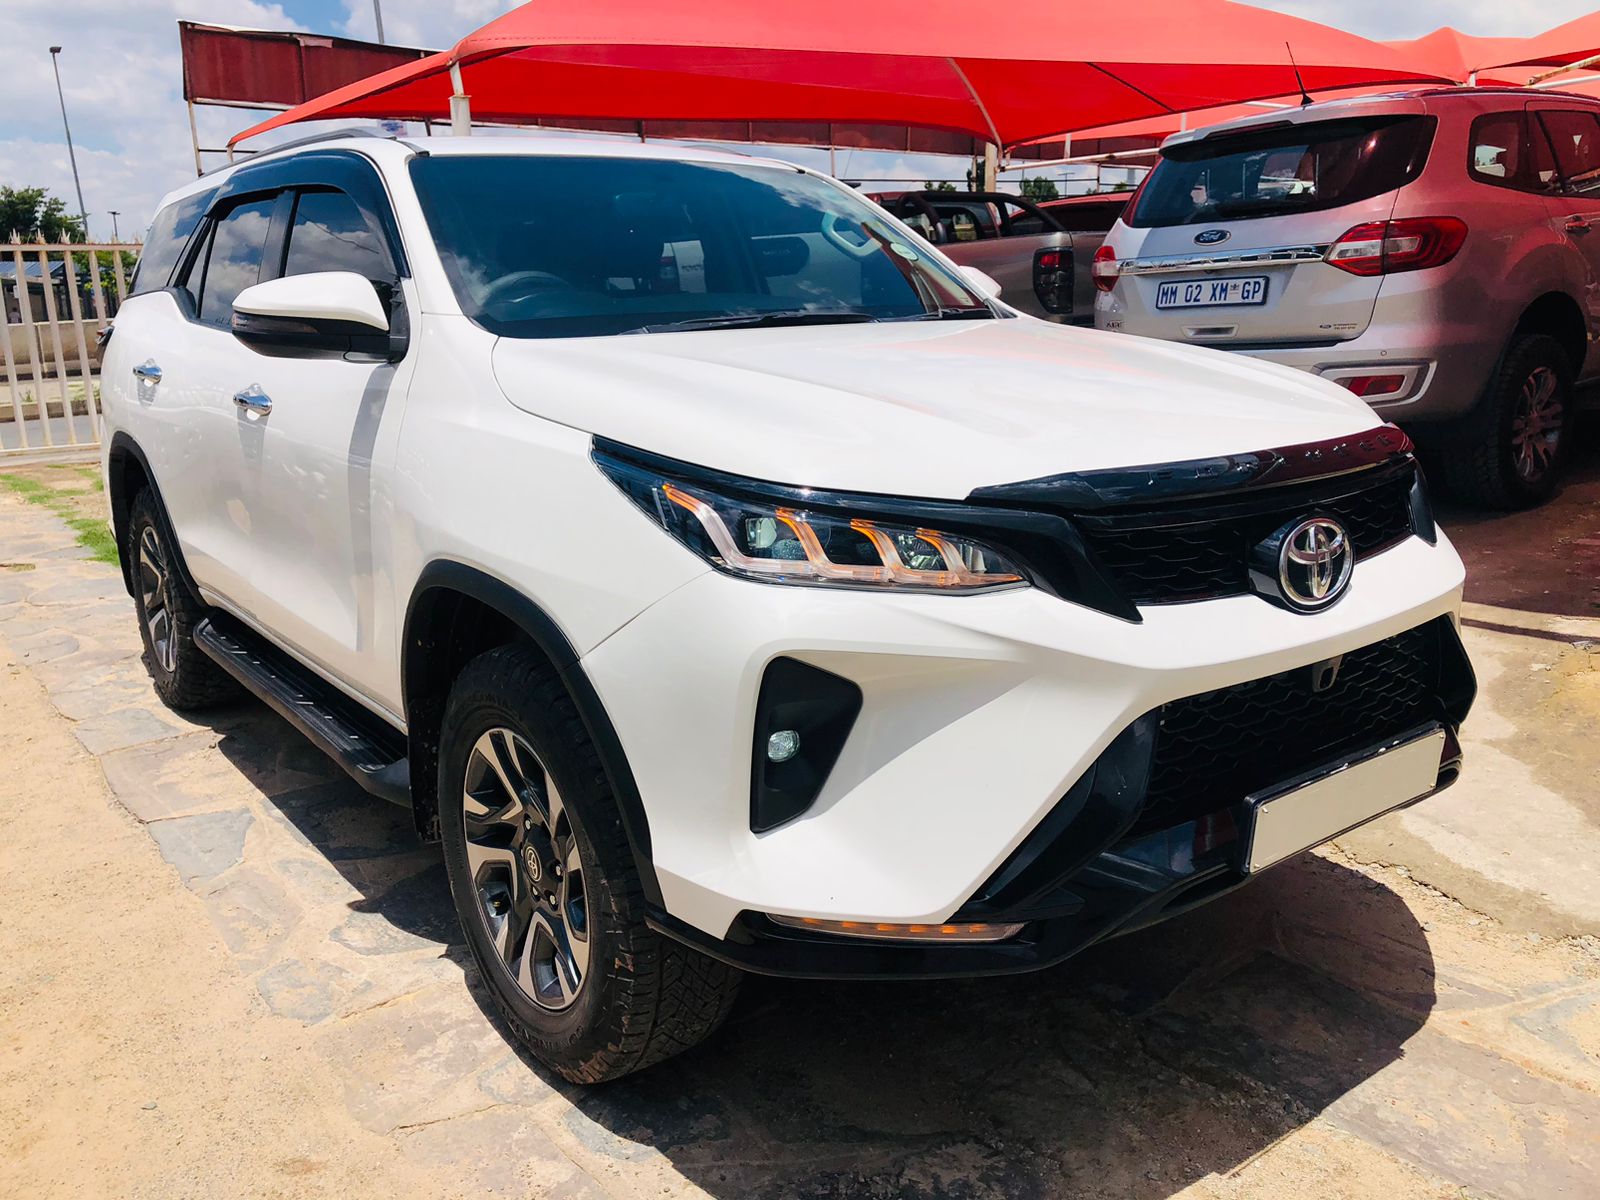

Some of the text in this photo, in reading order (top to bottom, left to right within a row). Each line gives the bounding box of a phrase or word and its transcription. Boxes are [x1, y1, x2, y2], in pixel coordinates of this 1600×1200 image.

[1160, 281, 1261, 305] MM 02 XM GP
